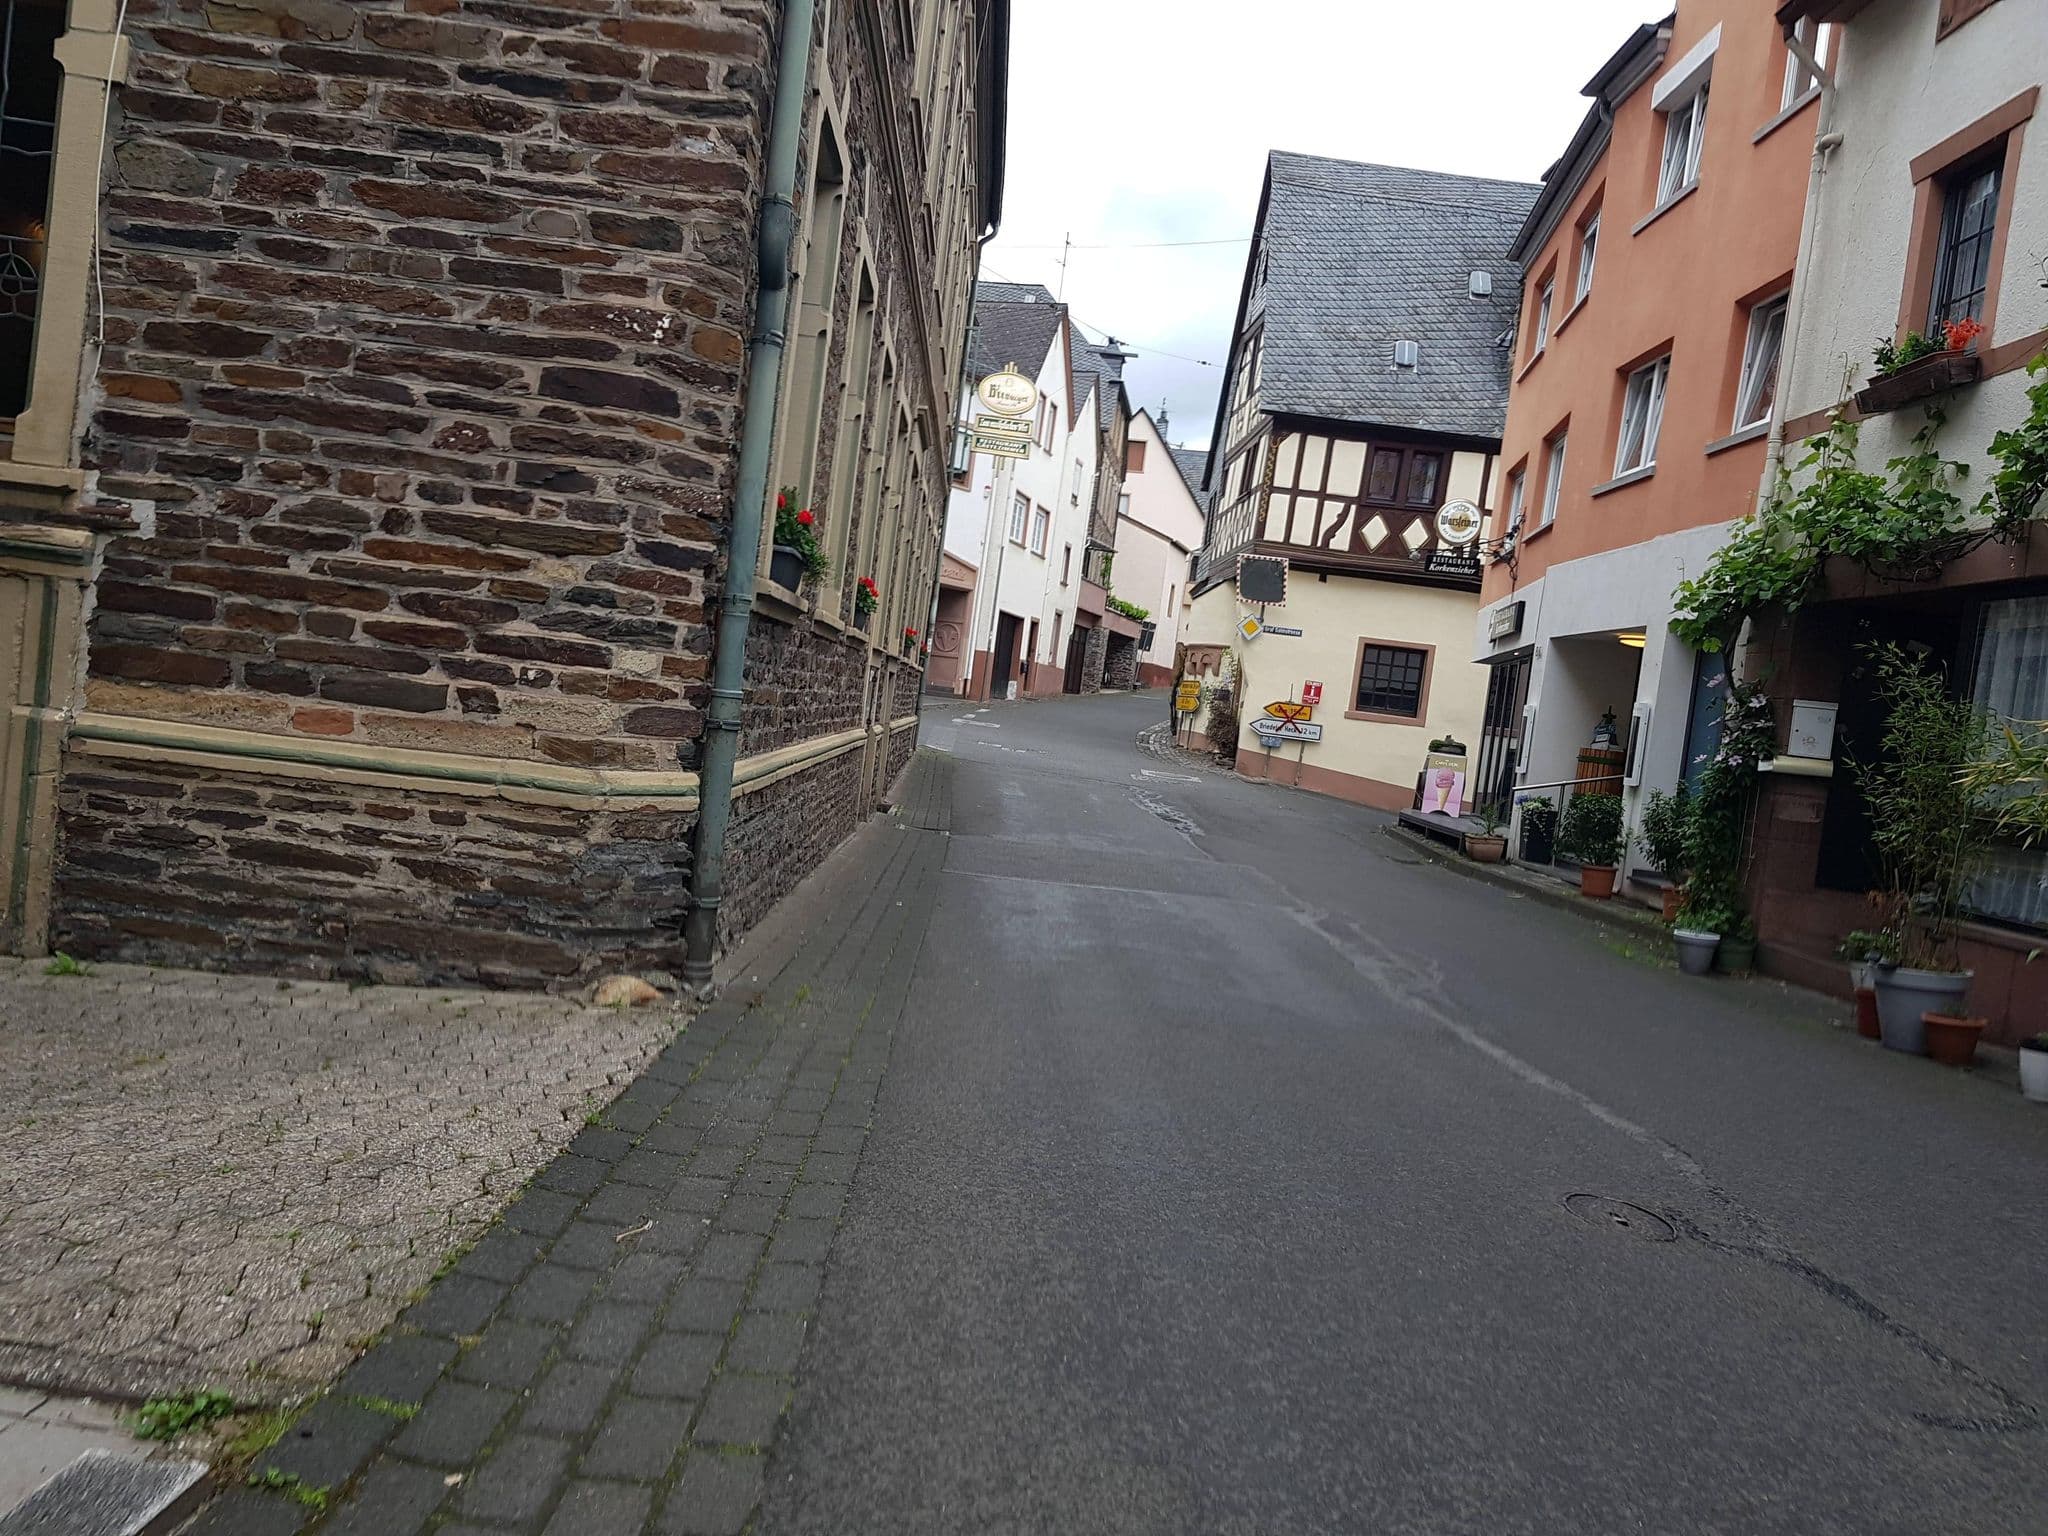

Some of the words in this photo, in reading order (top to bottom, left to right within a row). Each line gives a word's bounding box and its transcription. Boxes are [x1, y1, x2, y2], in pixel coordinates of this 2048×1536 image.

[1441, 514, 1479, 529] Warsteiner
[1432, 556, 1475, 566] RESTAURANT
[1428, 563, 1477, 575] Korkenzieher
